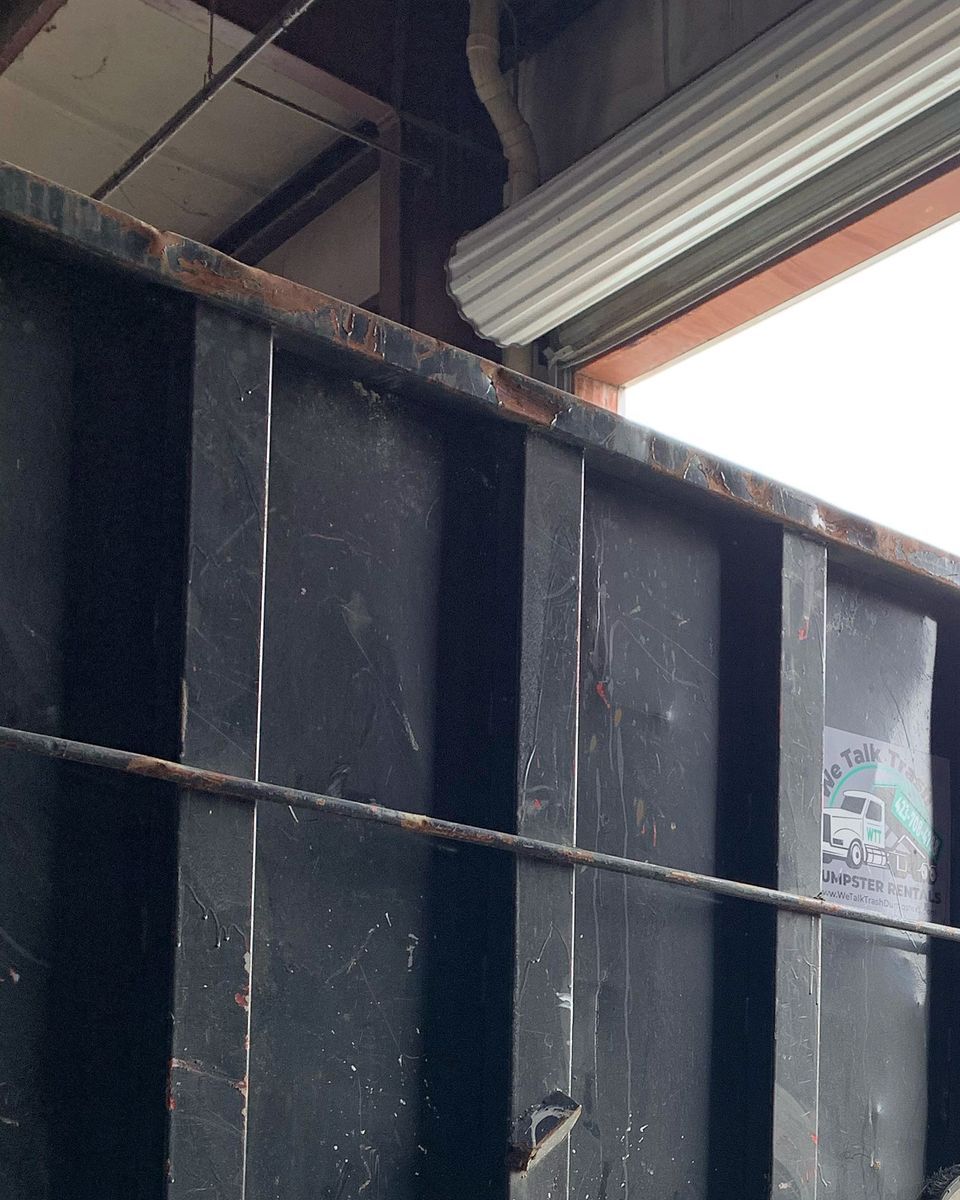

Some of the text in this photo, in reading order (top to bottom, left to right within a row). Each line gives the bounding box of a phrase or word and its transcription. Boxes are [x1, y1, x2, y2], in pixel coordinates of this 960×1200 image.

[840, 743, 881, 769] Talk
[866, 826, 883, 845] WTT
[822, 871, 884, 893] UMPSTER
